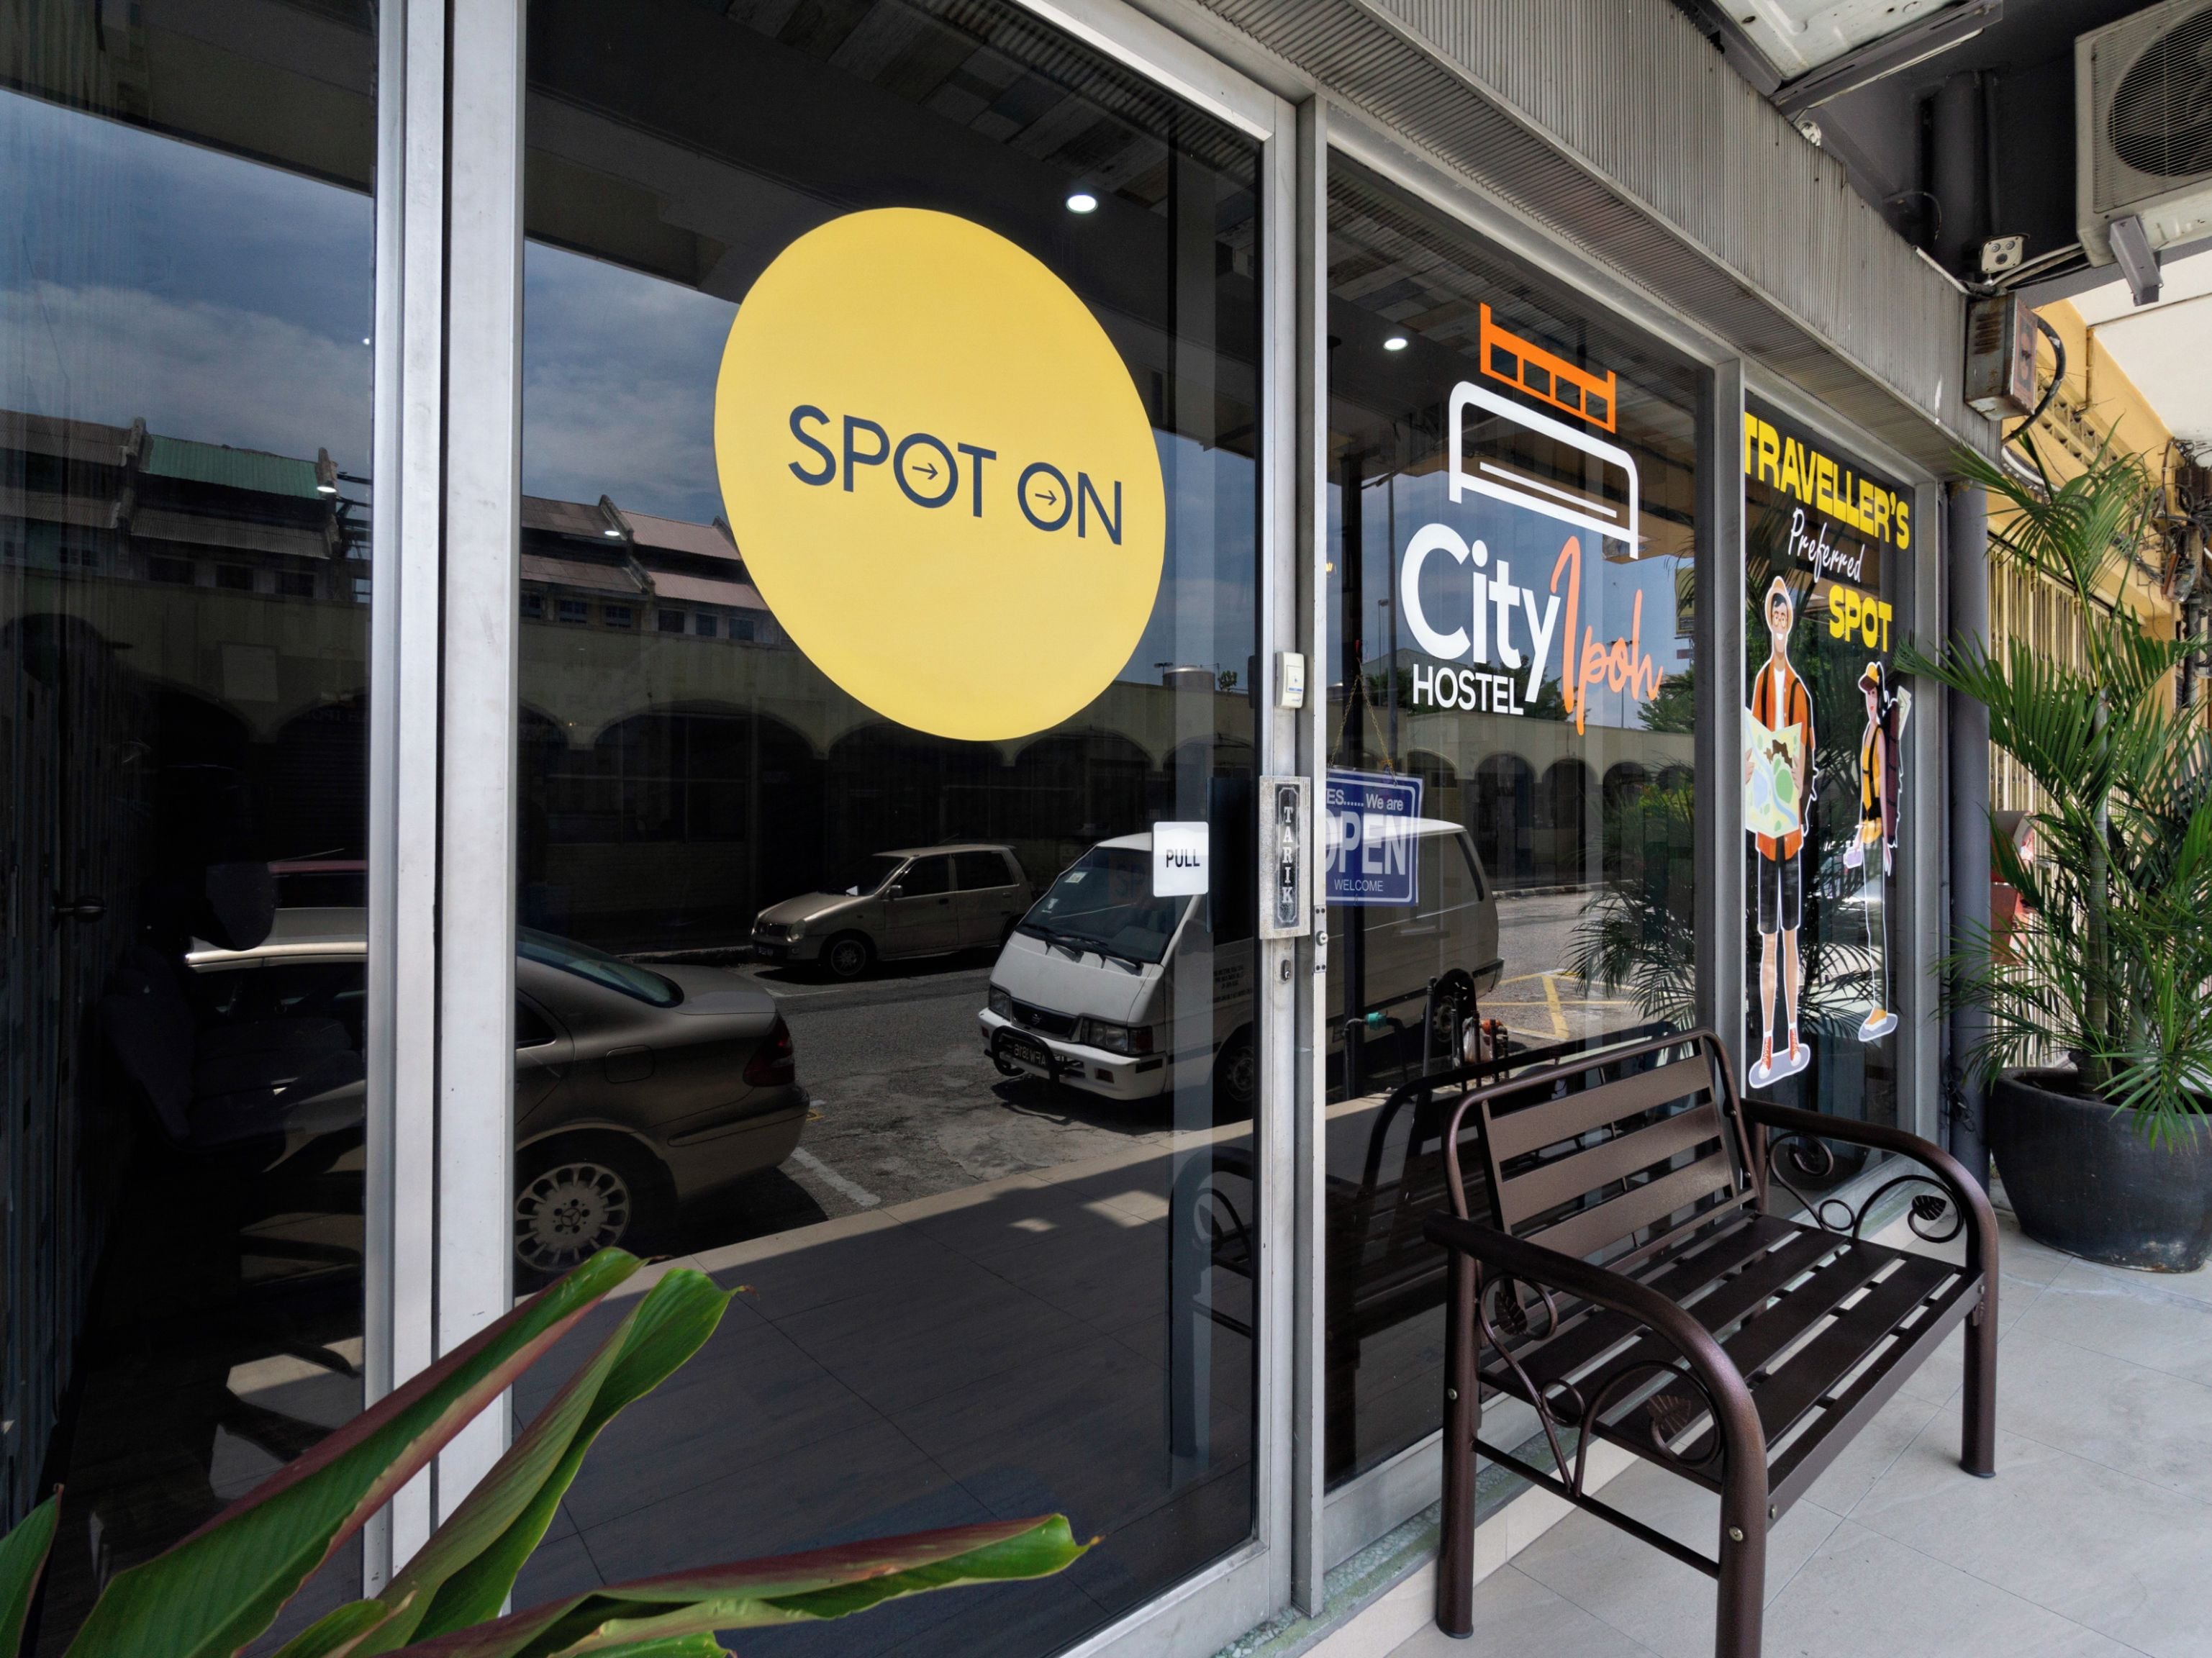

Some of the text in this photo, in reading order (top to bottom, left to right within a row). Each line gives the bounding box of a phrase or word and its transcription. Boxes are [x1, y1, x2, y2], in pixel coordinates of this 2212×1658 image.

[787, 404, 1123, 546] SPOT ON
[1744, 411, 1910, 551] TRAVELLER'S
[1788, 507, 1865, 583] Preferred
[1400, 522, 1561, 703] City
[1828, 584, 1893, 653] SPOT
[1413, 663, 1525, 716] HOSTEL
[1366, 793, 1384, 810] We
[1387, 799, 1404, 812] are
[1165, 848, 1201, 869] PULL
[1282, 806, 1294, 905] TARIK
[1334, 879, 1384, 892] WELCOME
